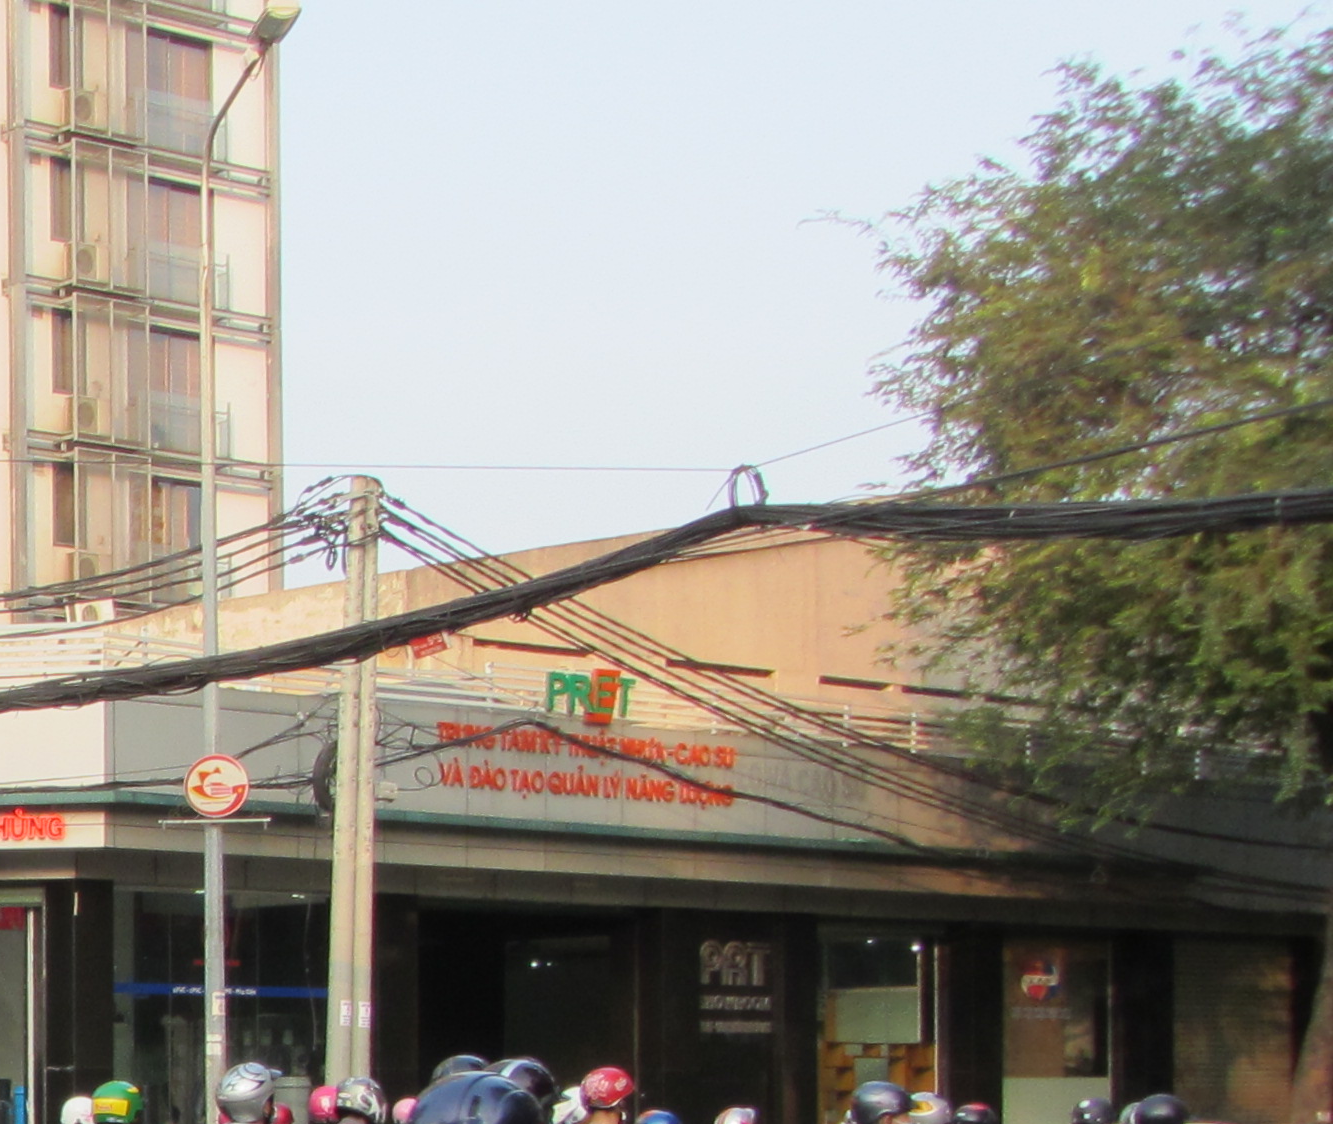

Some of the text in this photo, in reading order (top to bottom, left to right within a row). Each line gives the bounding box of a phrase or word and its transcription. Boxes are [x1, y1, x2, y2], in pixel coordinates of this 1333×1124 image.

[545, 670, 636, 718] PRET
[442, 757, 464, 788] VÀ
[469, 760, 506, 791] ĐÀO
[510, 769, 545, 799] TẠO
[548, 764, 600, 797] QUẢN
